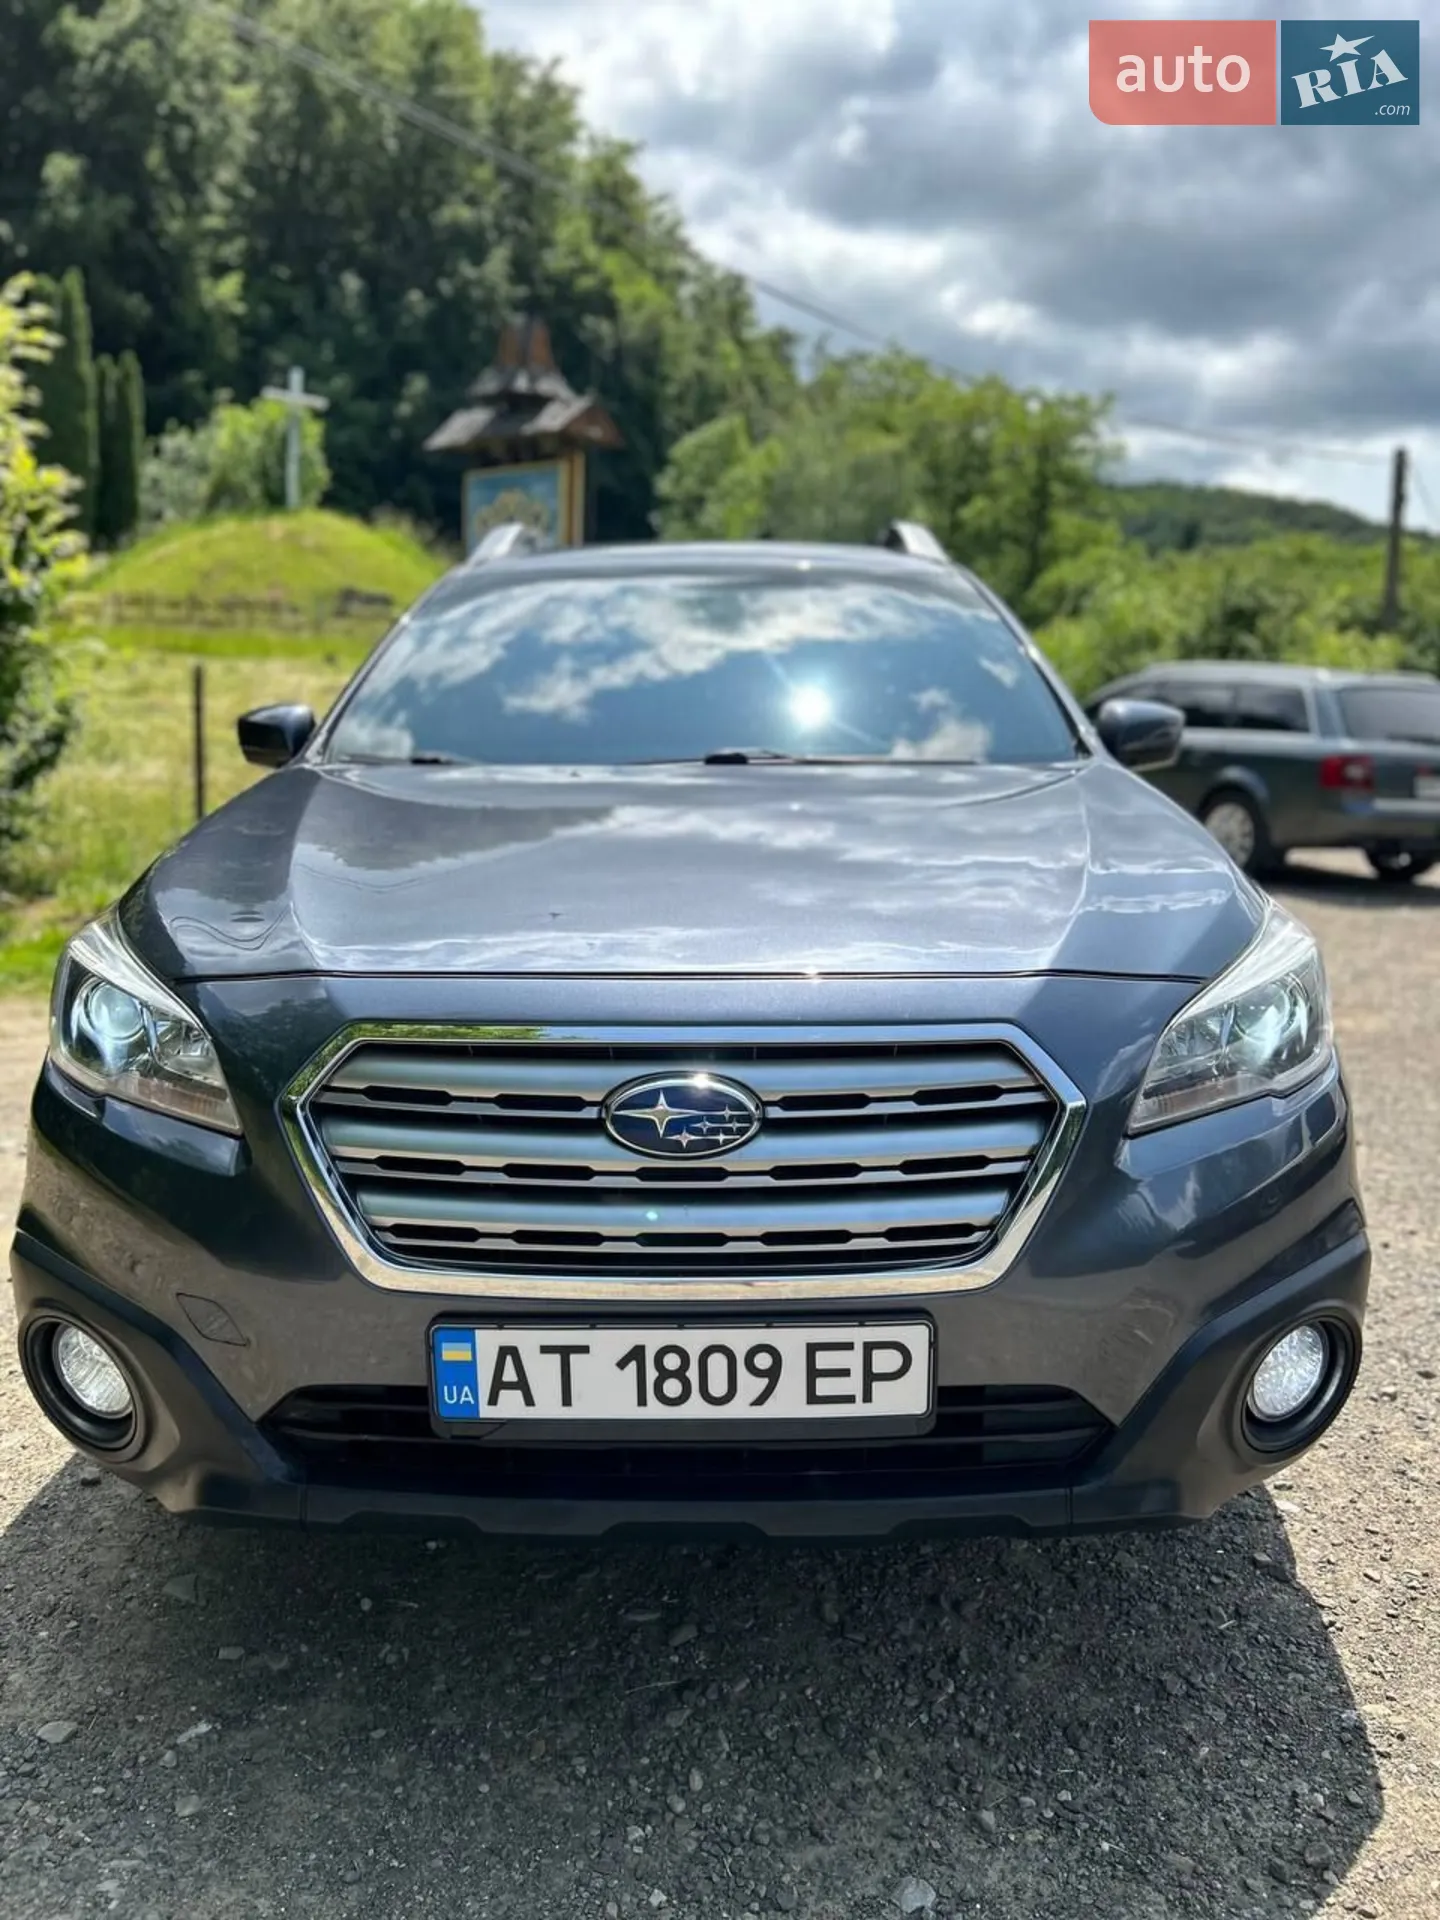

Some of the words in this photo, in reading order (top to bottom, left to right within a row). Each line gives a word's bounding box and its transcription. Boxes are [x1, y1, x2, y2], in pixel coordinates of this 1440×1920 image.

[443, 1385, 475, 1405] UA
[487, 1345, 590, 1407] AT
[615, 1343, 783, 1408] 1809
[805, 1340, 913, 1405] EP
